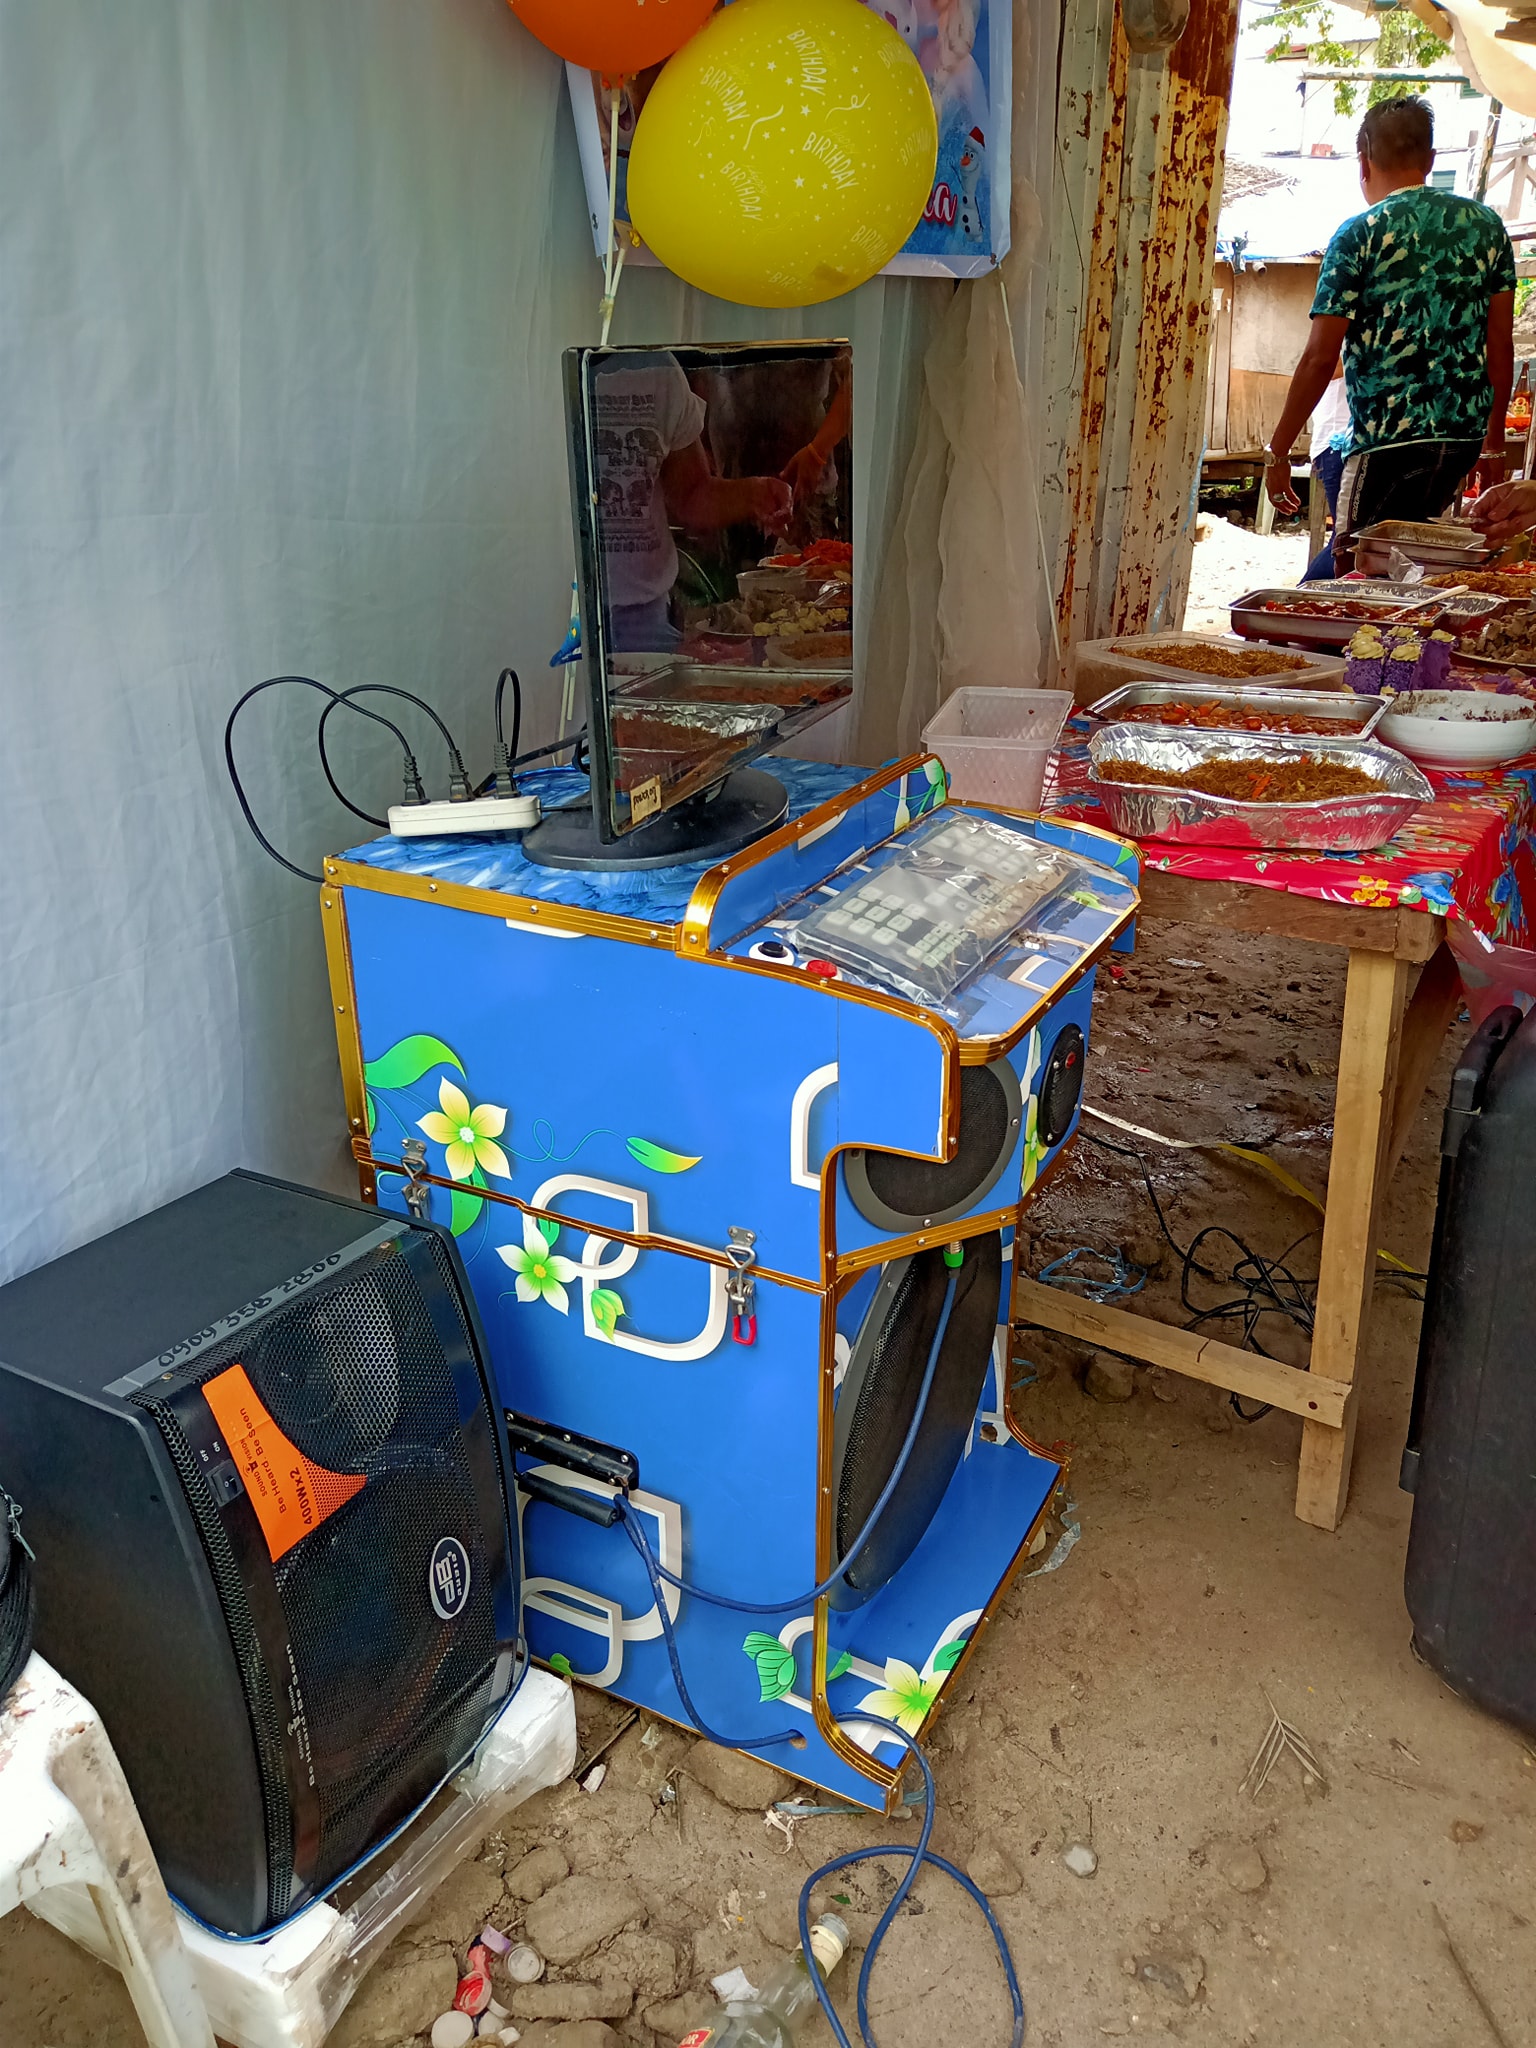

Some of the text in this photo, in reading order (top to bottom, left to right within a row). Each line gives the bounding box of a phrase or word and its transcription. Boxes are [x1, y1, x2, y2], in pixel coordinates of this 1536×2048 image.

[786, 28, 827, 97] BIRTHDAY
[701, 65, 750, 123] BIRTHDAY
[802, 131, 860, 190] BIRTHDAY
[720, 160, 763, 221] BIRTHDAY
[158, 1253, 341, 1367] 0909 358 2800
[200, 1449, 209, 1462] OFF
[212, 1441, 221, 1453] ON
[239, 1438, 268, 1497] SOUND VISION
[254, 1439, 263, 1457] Be
[278, 1496, 287, 1514] Be
[289, 1466, 313, 1525] 400Wx2
[308, 1765, 315, 1787] Be
